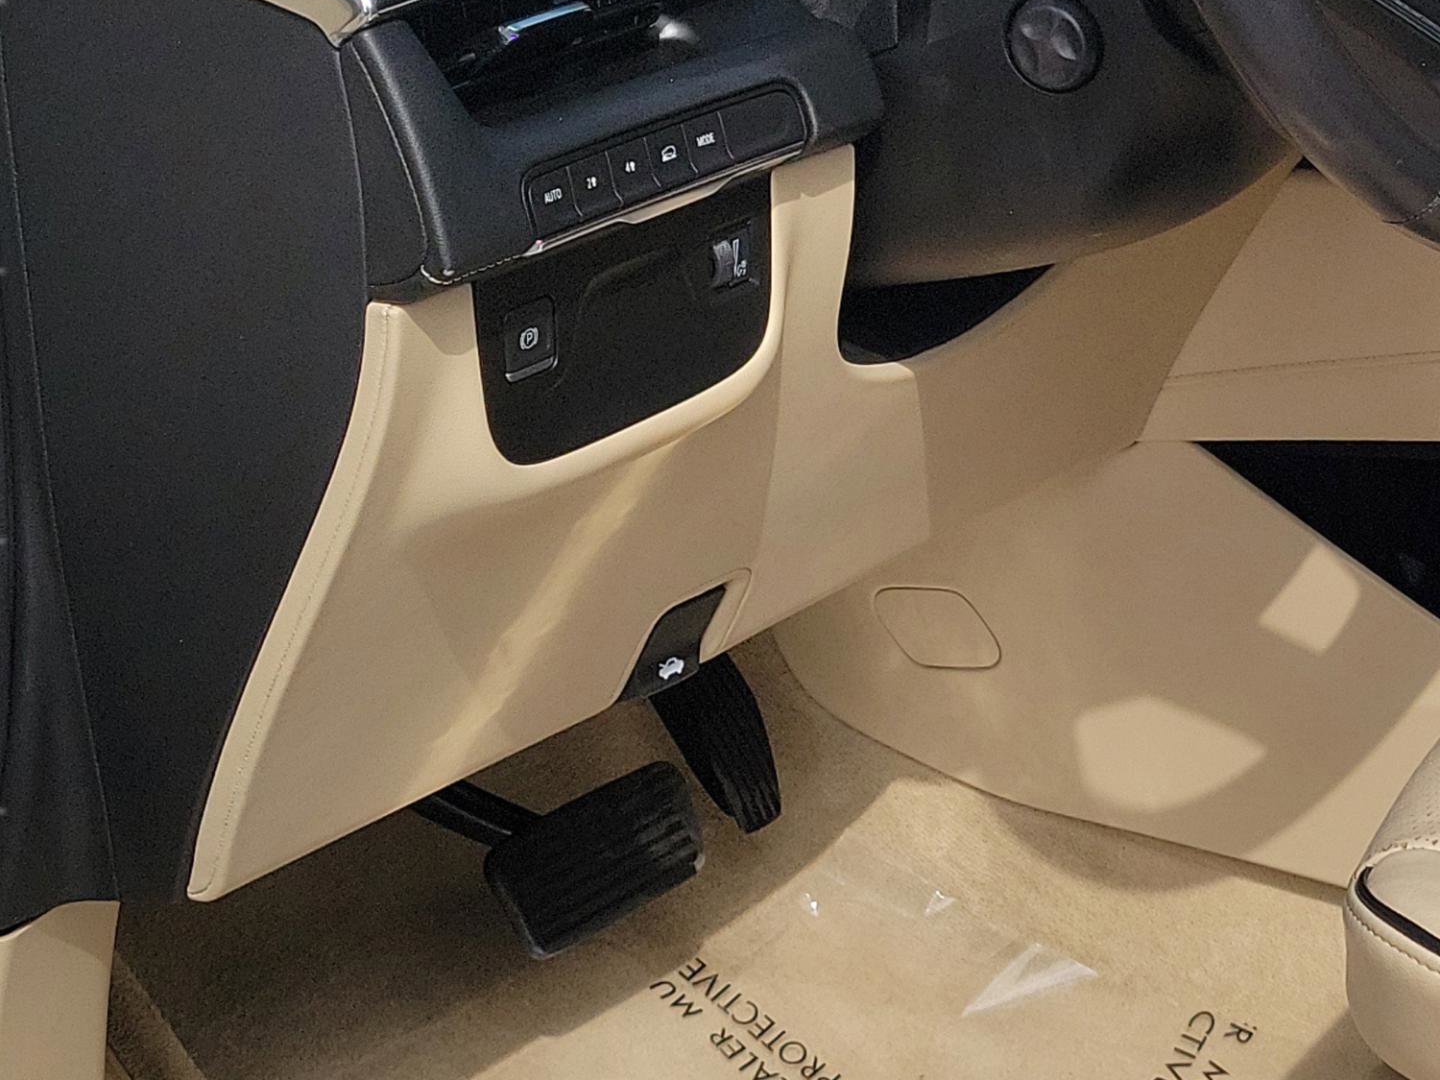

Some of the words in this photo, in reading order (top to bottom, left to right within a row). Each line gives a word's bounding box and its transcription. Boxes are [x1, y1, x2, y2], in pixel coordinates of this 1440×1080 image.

[696, 132, 715, 147] MODE
[544, 187, 562, 204] AUTO
[649, 980, 703, 1018] MU
[709, 1027, 787, 1080] ALER
[1153, 1011, 1215, 1080] CTIV
